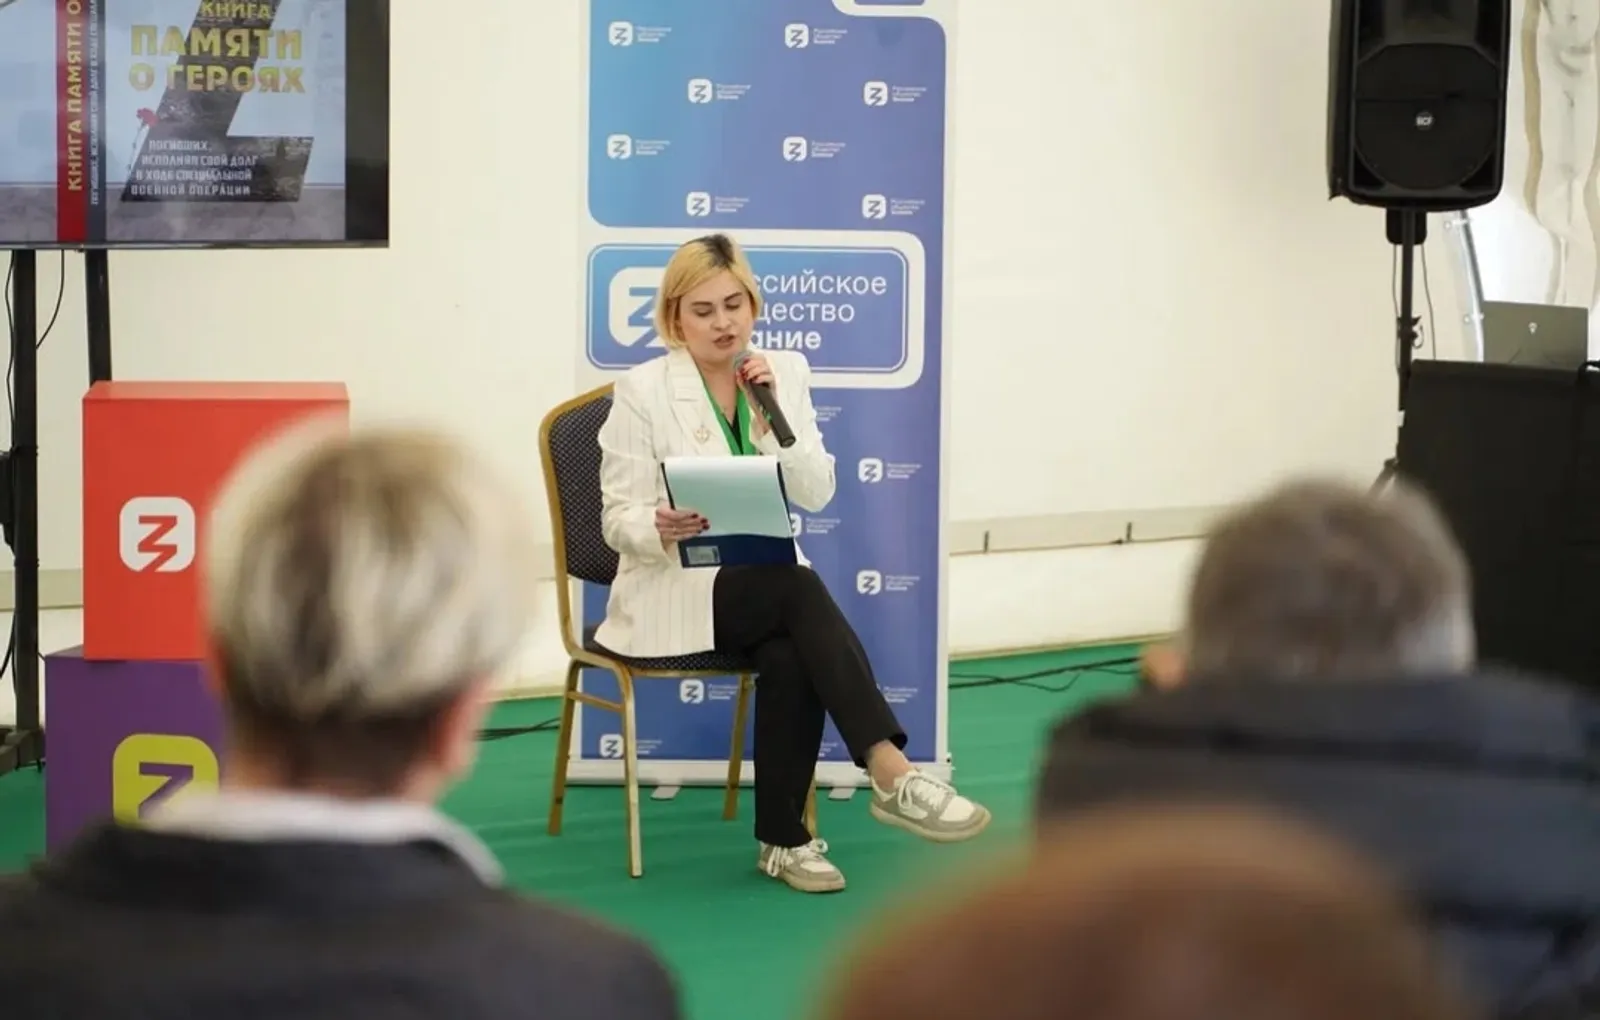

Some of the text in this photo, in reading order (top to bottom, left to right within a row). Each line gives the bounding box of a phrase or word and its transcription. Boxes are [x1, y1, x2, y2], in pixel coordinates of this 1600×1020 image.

[201, 1, 273, 19] КНИГА
[130, 24, 303, 60] ПАМЯТИ
[66, 22, 82, 113] ПАМЯТИ
[128, 62, 306, 94] О ГЕРОЯХ
[67, 119, 83, 191] КНИГА
[750, 329, 822, 350] ание
